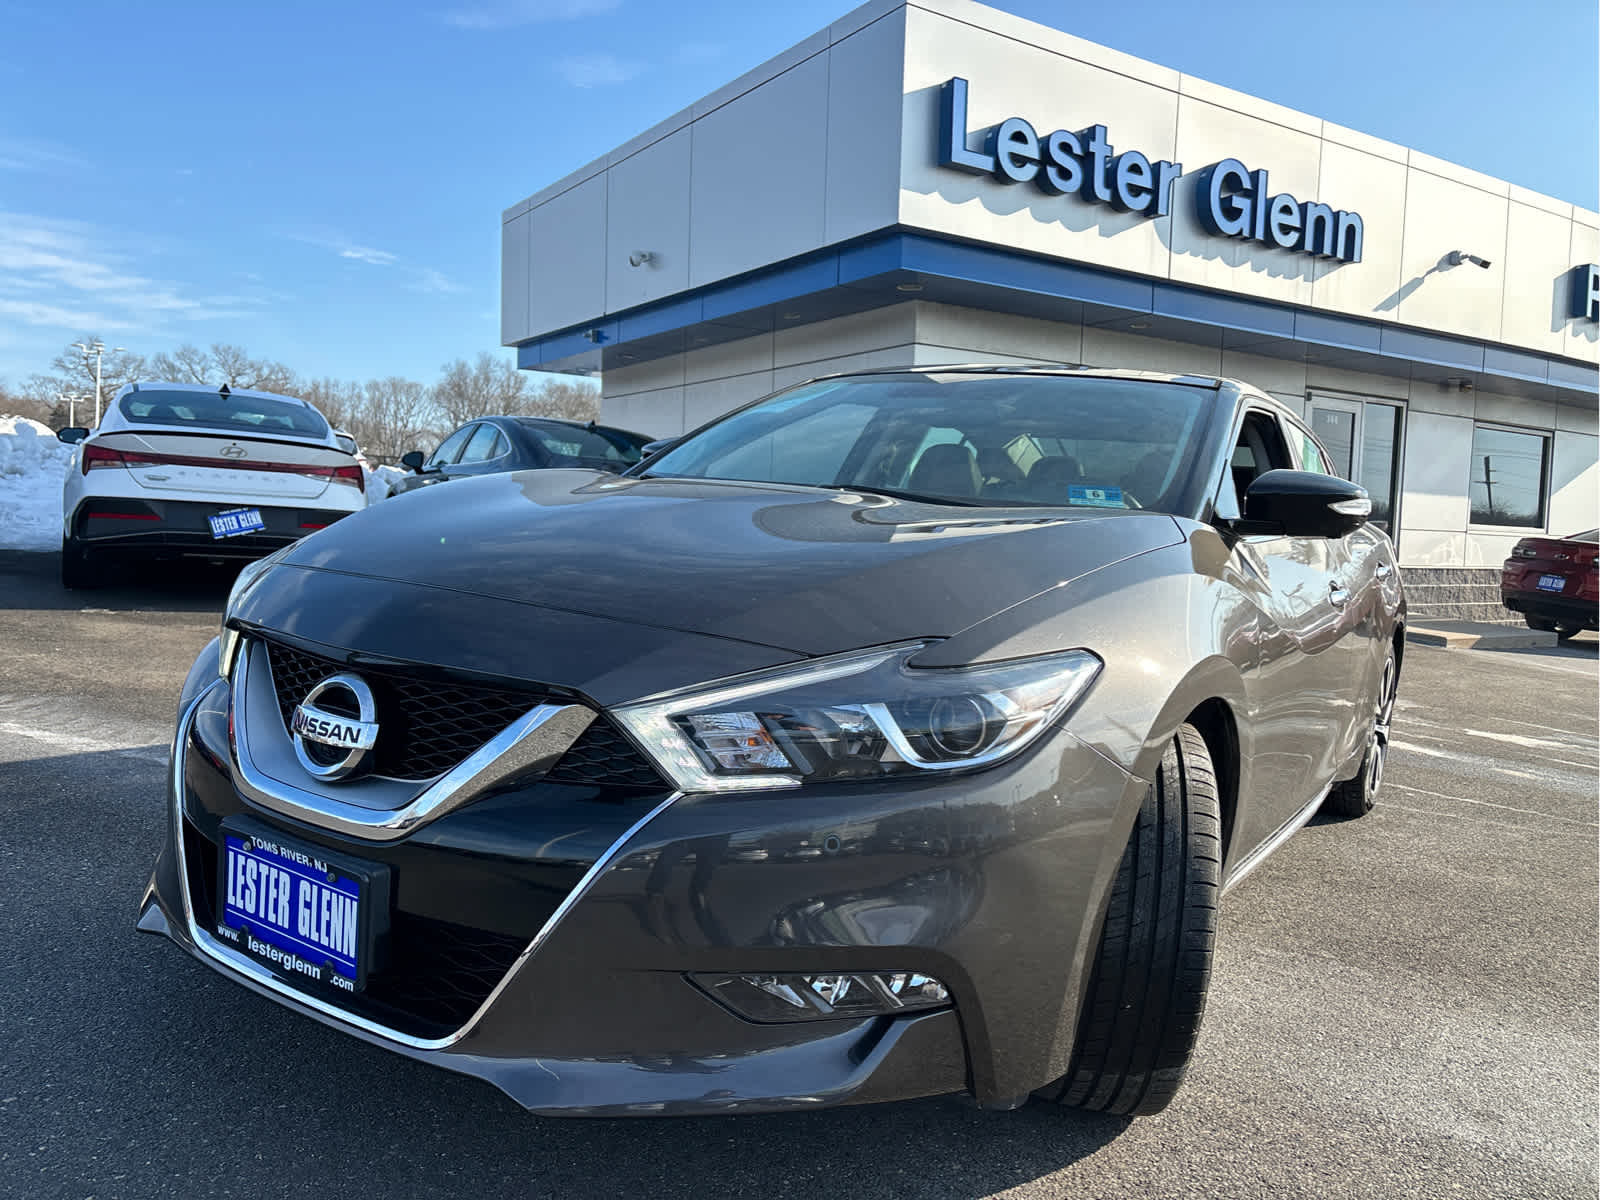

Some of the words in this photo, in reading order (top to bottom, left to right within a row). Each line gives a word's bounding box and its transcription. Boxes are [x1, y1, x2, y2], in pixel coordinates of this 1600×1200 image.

[941, 76, 1182, 217] Lester
[1204, 158, 1363, 263] Glenn
[295, 710, 361, 744] NISSAN
[250, 835, 279, 855] TOMS
[314, 859, 328, 873] NJ
[227, 851, 291, 929] LESTER
[298, 879, 358, 959] GLENN
[217, 924, 239, 942] www.
[248, 935, 321, 980] lesterglenn
[330, 975, 354, 992] .com
